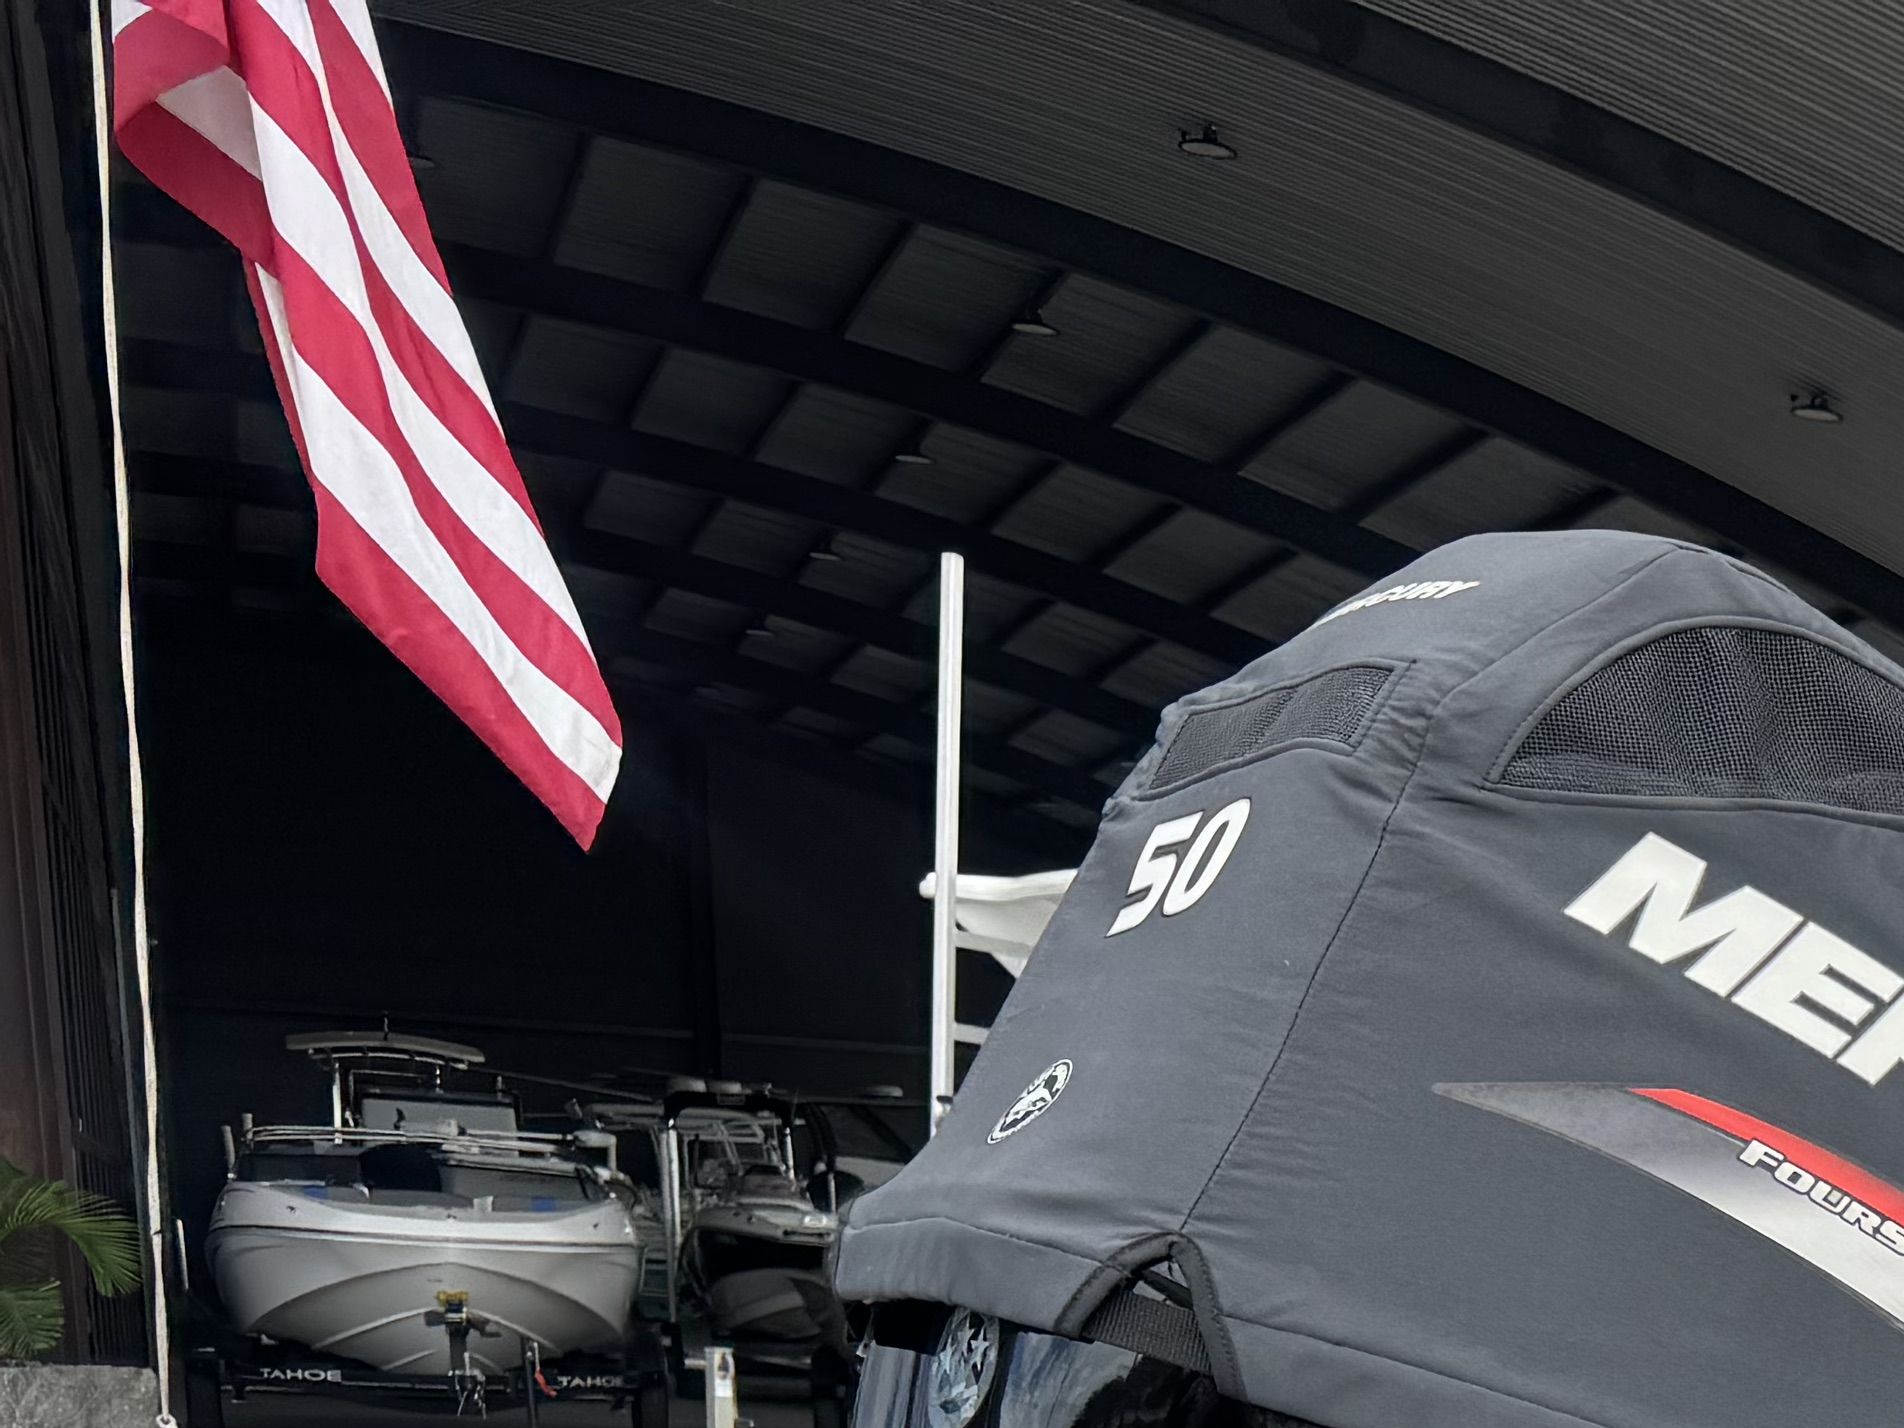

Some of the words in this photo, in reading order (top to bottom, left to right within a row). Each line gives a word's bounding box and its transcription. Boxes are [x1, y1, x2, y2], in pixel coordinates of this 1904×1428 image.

[1106, 797, 1252, 938] 50
[259, 1368, 342, 1382] TAHOE
[557, 1375, 626, 1389] TAHOE
